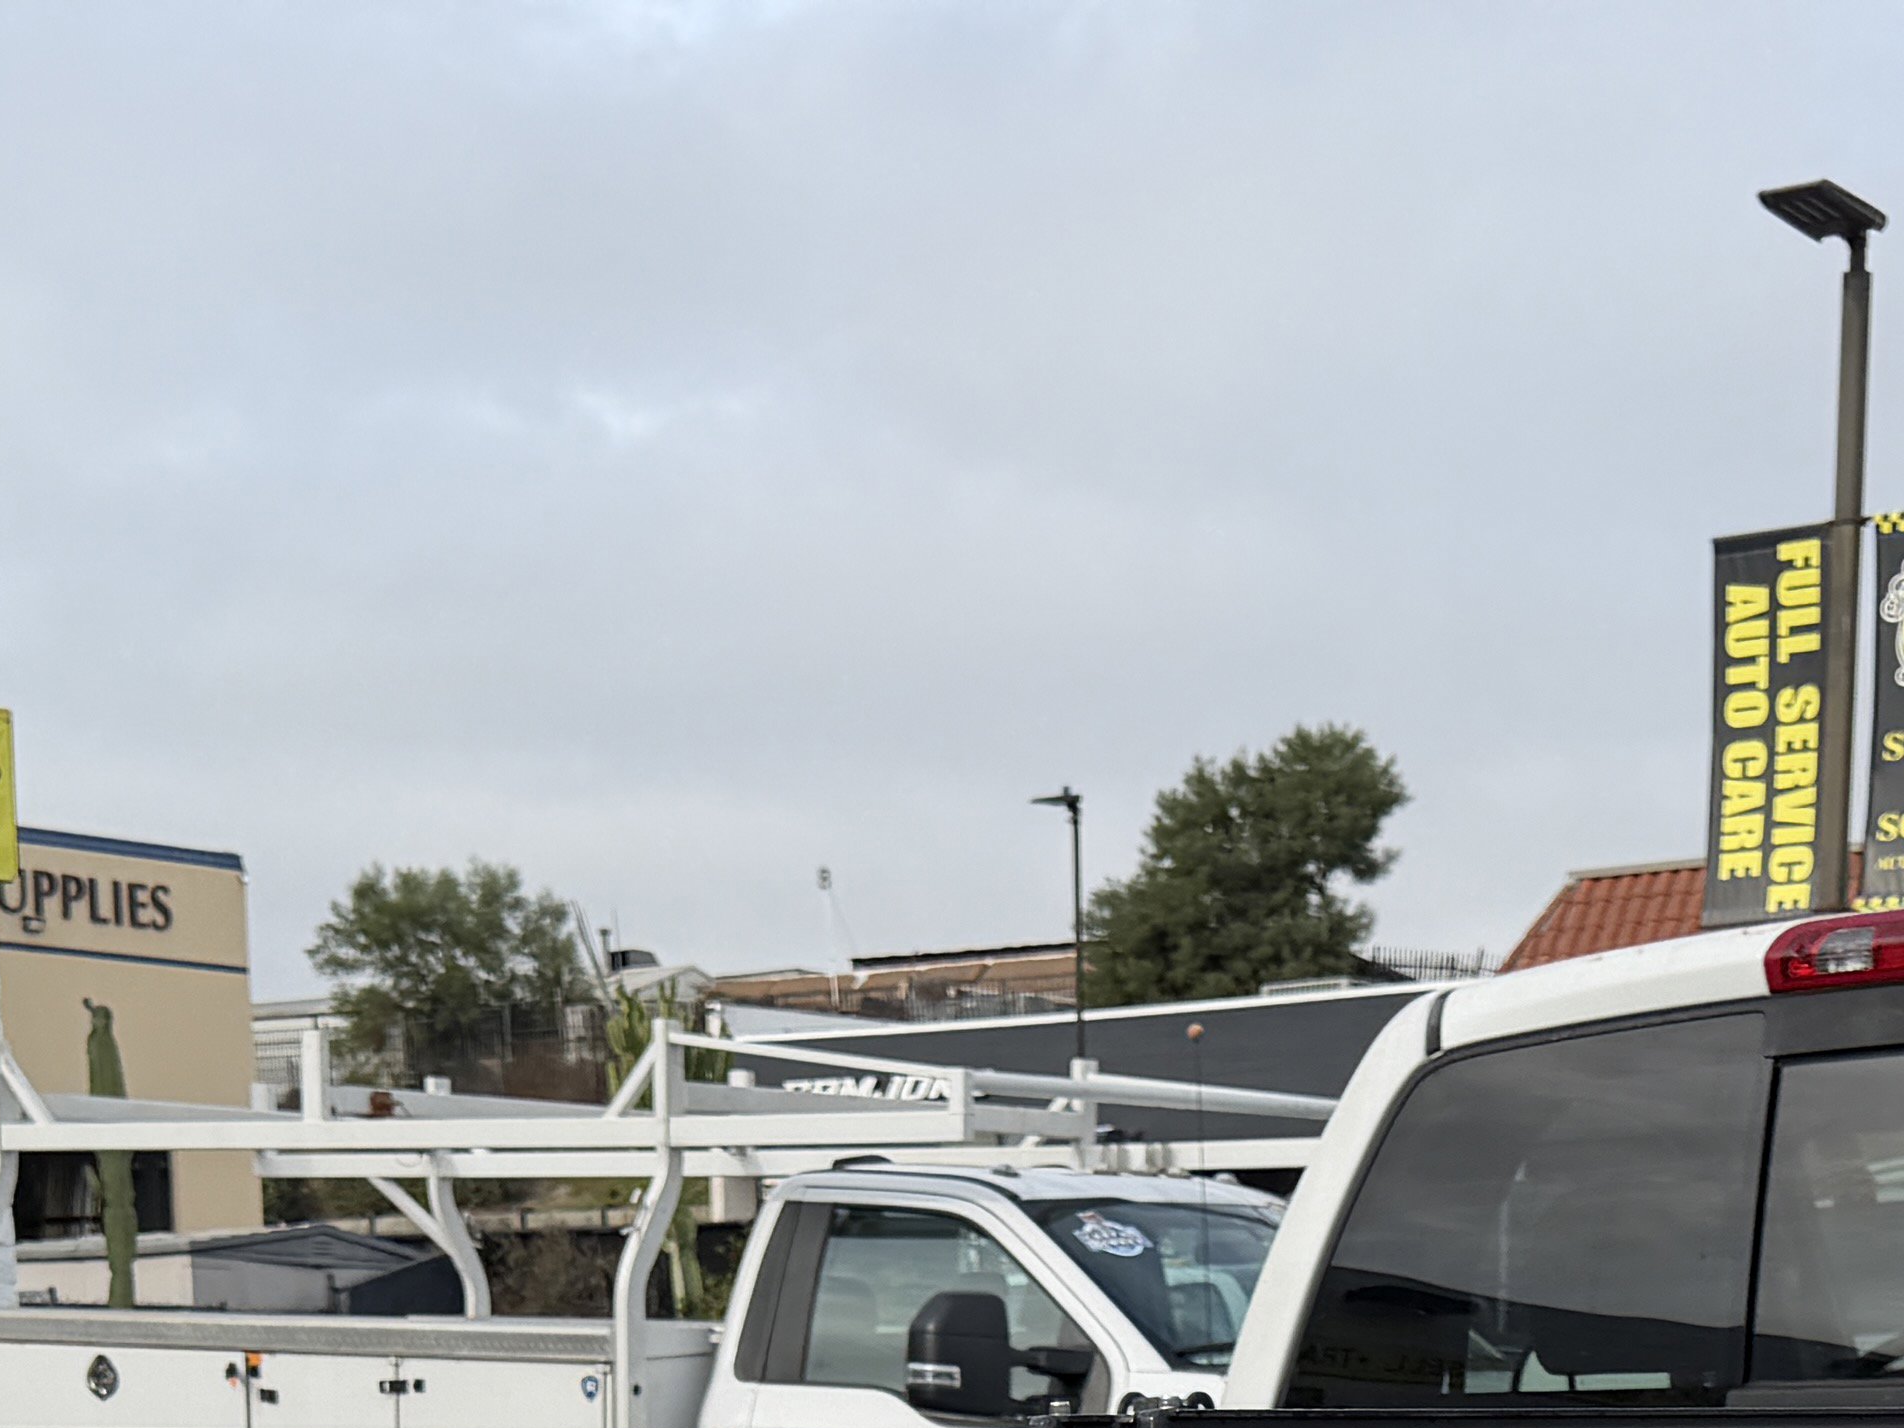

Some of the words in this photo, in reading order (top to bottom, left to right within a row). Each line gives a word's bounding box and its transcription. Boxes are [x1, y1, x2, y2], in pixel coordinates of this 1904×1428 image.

[1723, 584, 1770, 729] AUTO
[1775, 538, 1821, 664] FULL
[1717, 740, 1768, 881] CARE
[1765, 684, 1821, 914] SERVICE
